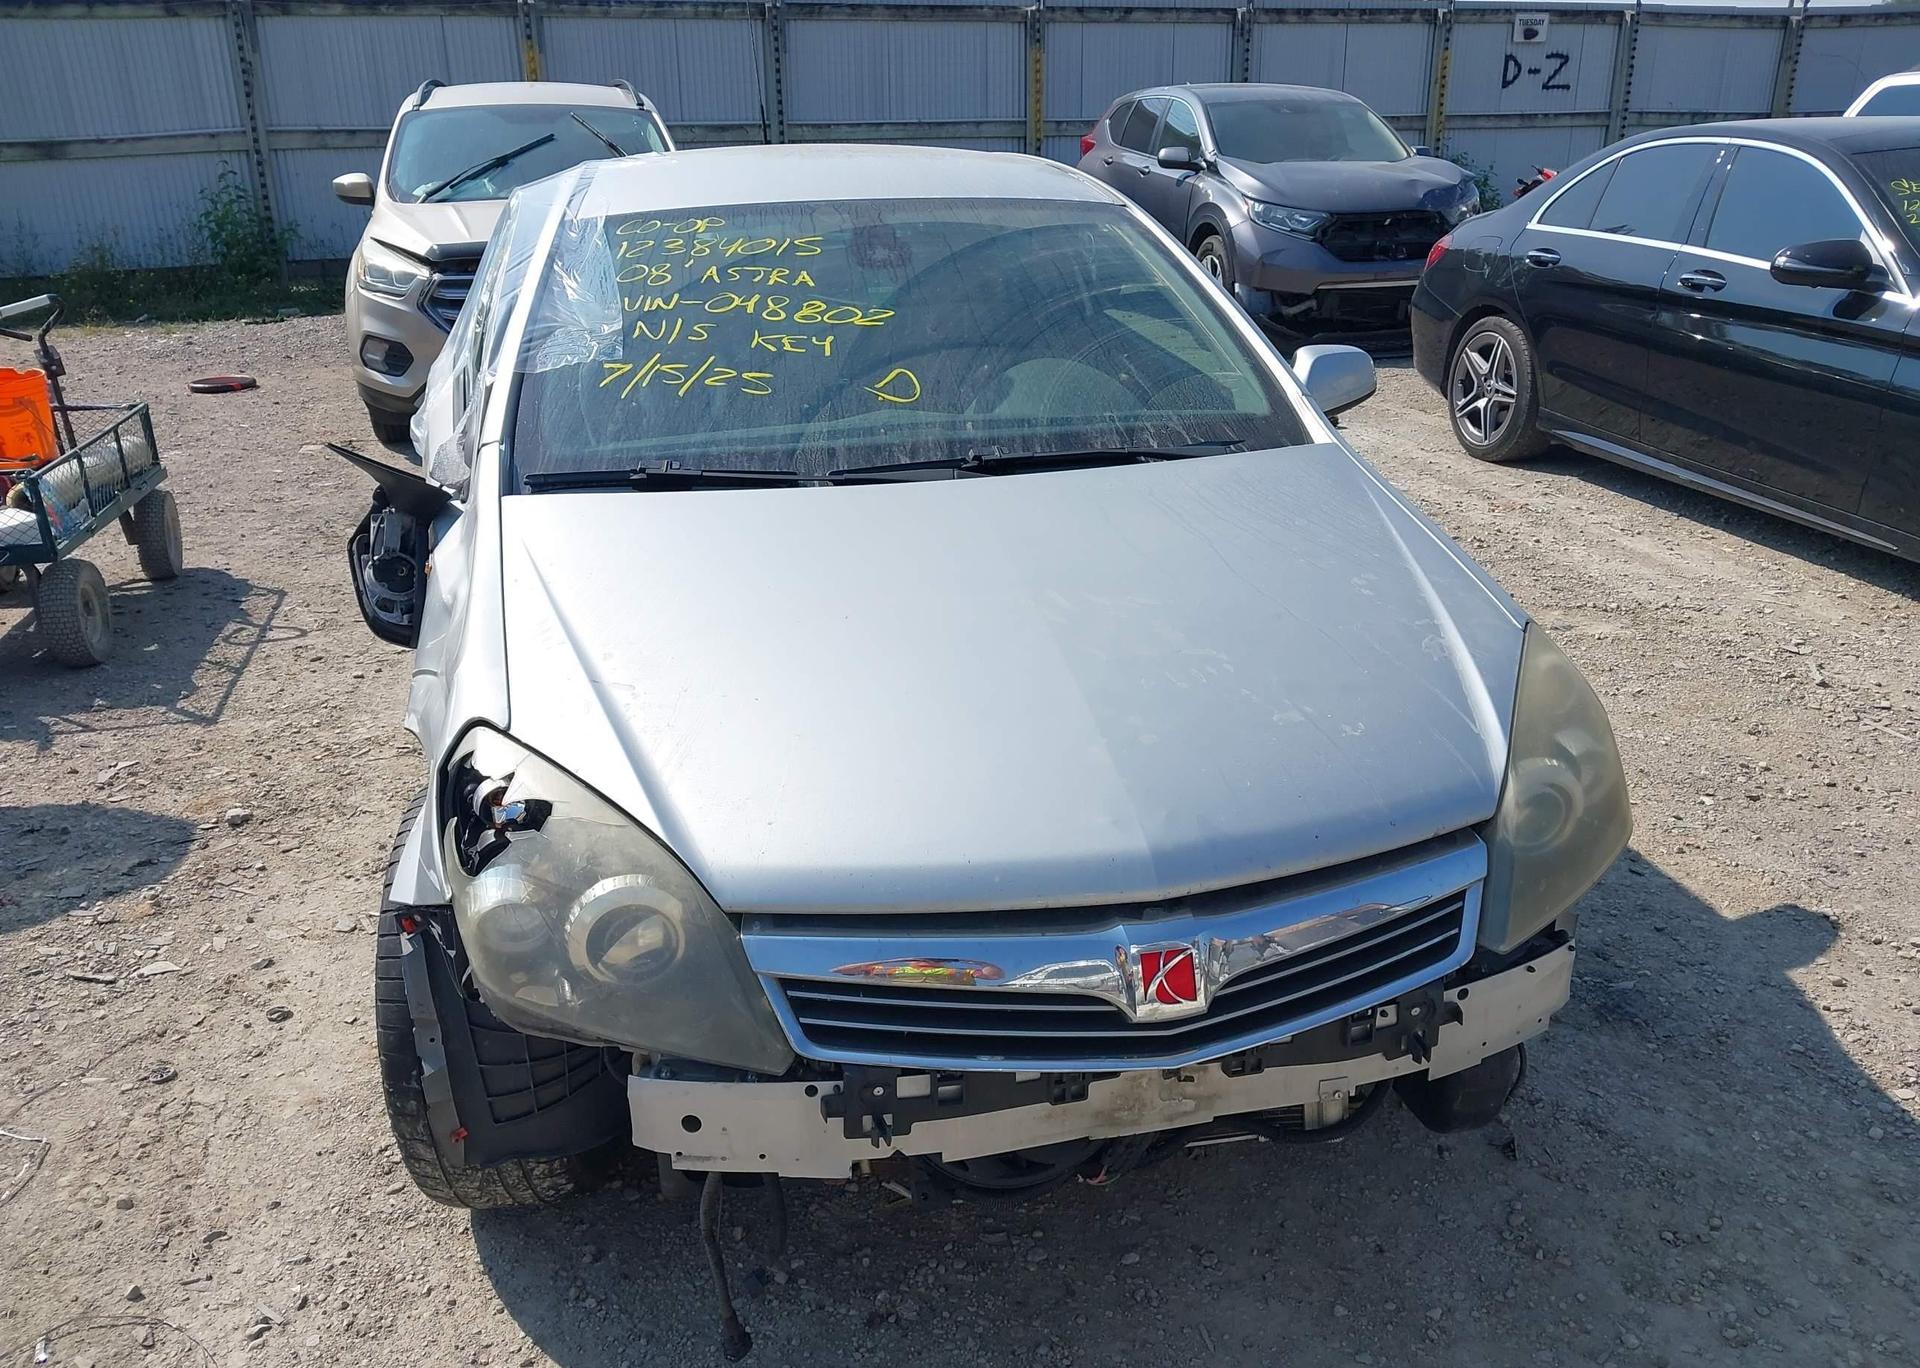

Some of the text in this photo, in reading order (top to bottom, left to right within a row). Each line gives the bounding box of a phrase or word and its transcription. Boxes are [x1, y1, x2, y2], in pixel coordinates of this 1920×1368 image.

[1518, 18, 1546, 27] TUESDAY
[616, 216, 726, 235] CO-OP
[616, 235, 824, 260] 12384015
[623, 291, 896, 326] VIN-048802
[750, 329, 835, 357] KEY
[599, 352, 775, 399] 7/15/25
